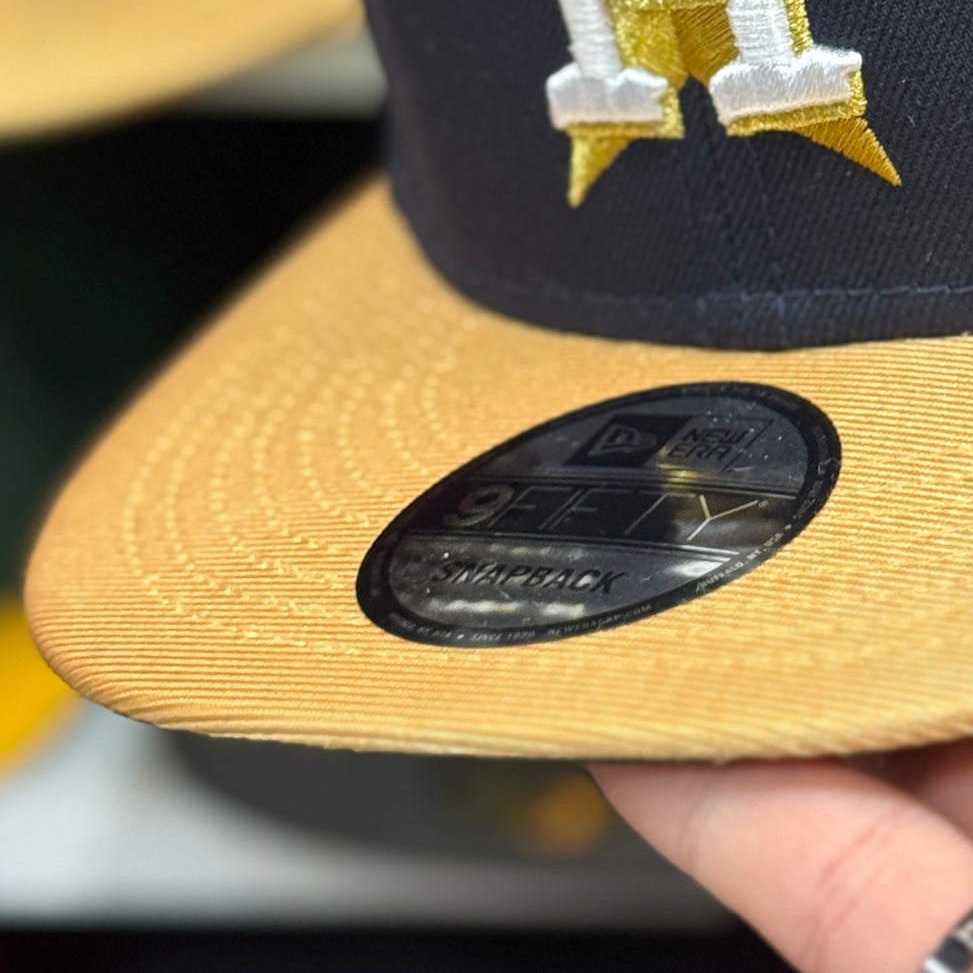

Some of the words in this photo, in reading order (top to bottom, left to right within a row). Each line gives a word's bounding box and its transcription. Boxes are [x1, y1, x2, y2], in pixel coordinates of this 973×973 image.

[682, 428, 752, 445] NEW
[667, 443, 732, 461] ERA
[444, 483, 760, 542] 9FIFTY
[432, 561, 627, 595] SNAPBACK
